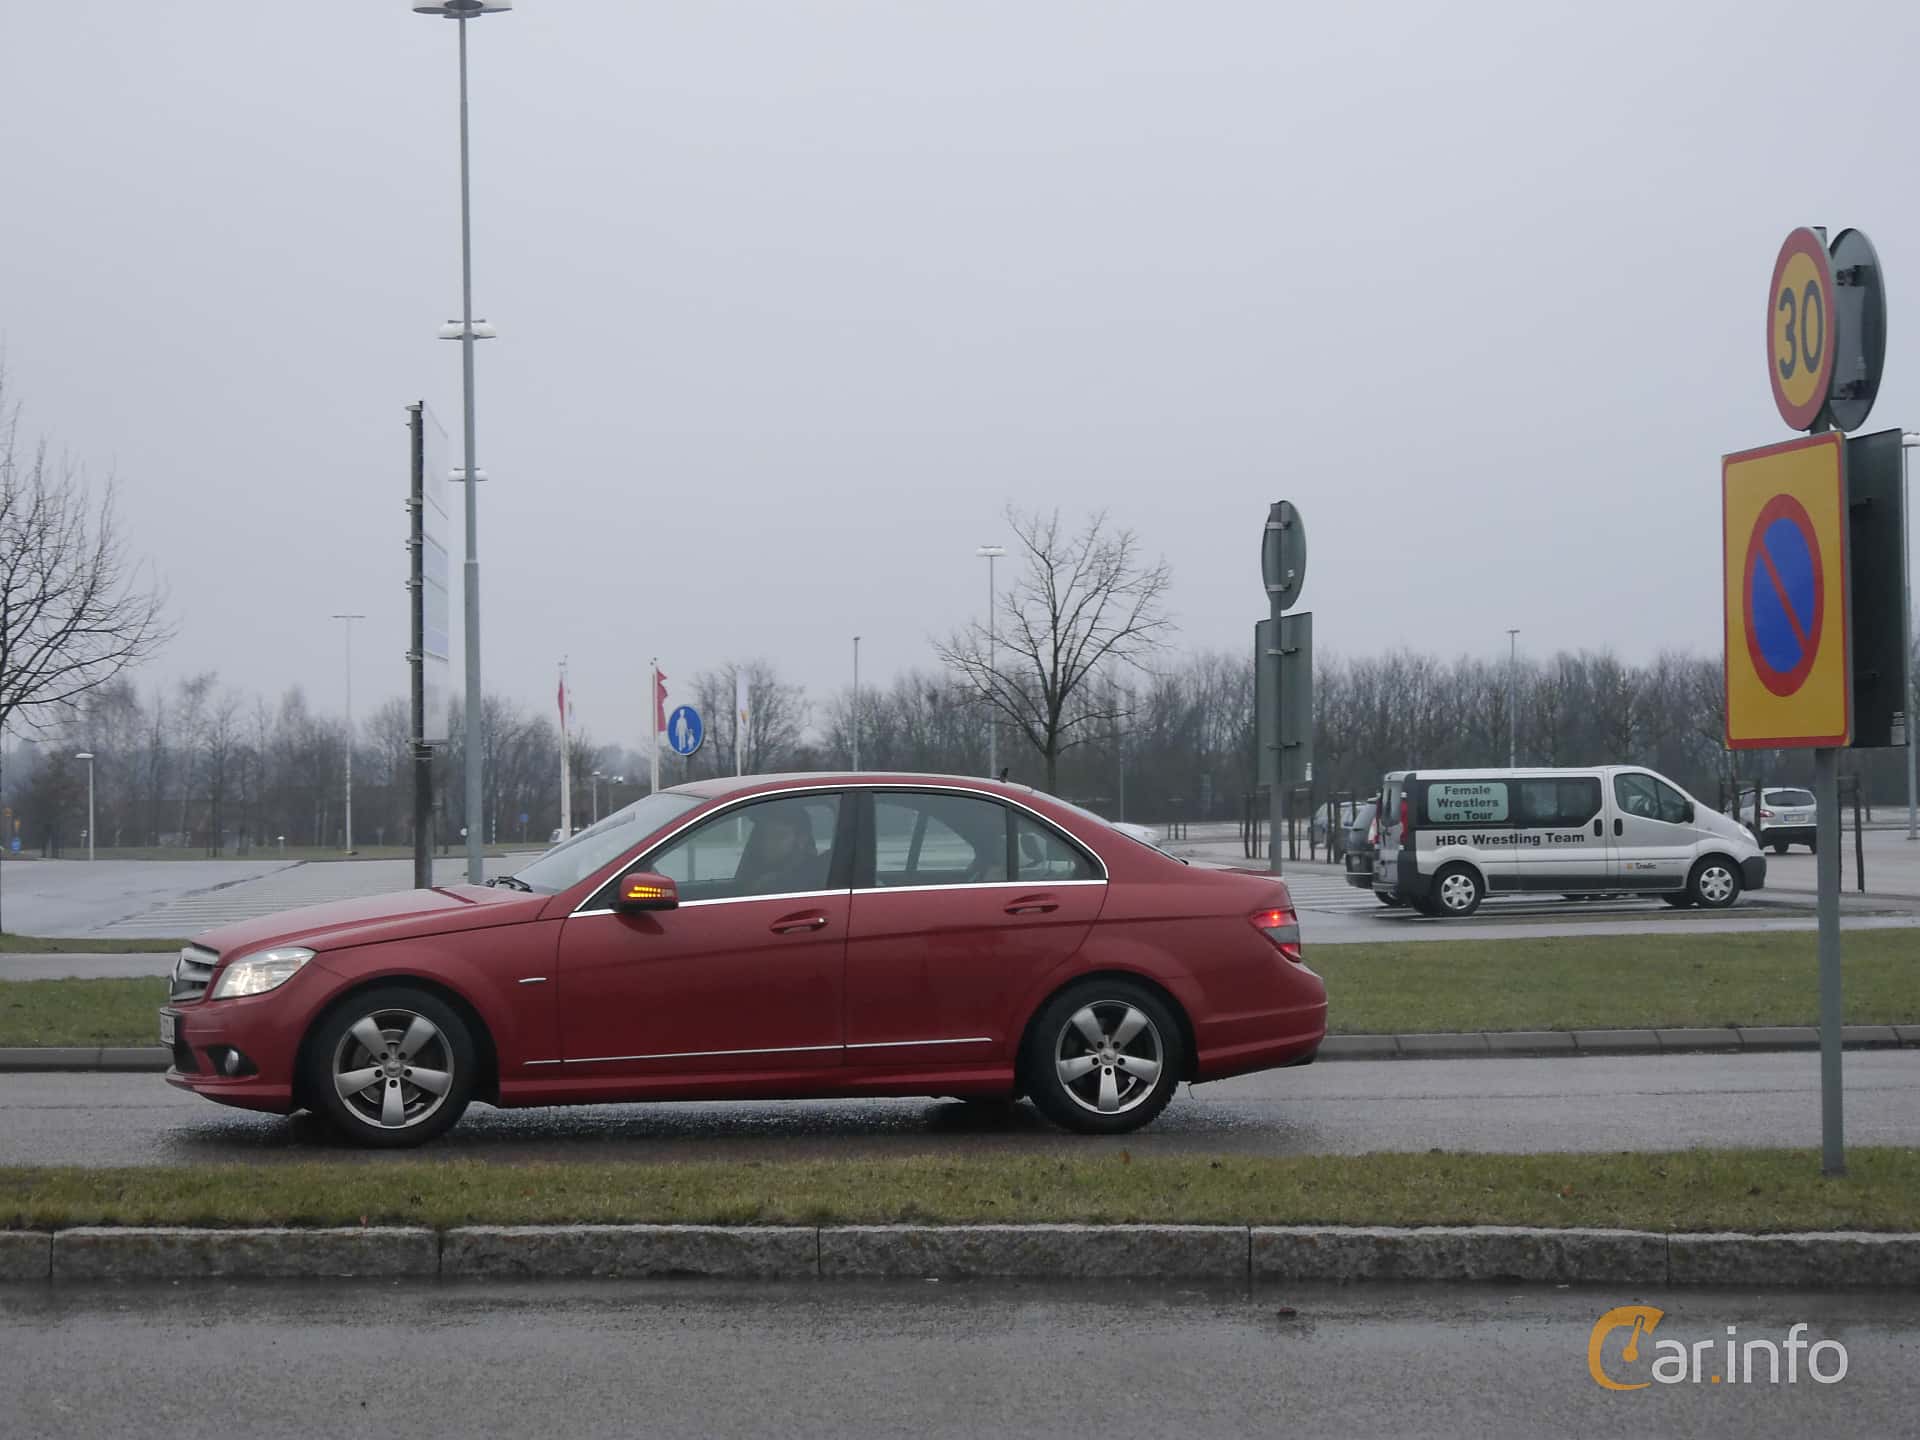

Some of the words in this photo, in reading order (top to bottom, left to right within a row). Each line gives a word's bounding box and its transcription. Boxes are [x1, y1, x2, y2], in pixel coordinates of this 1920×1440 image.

[1779, 279, 1824, 380] 30
[1444, 785, 1491, 795] Female
[1436, 797, 1499, 808] Wrestlers
[1444, 812, 1460, 820] on
[1463, 810, 1493, 820] Tour
[1435, 835, 1468, 846] HBG
[1471, 833, 1541, 847] Wrestling
[1544, 832, 1585, 843] Team
